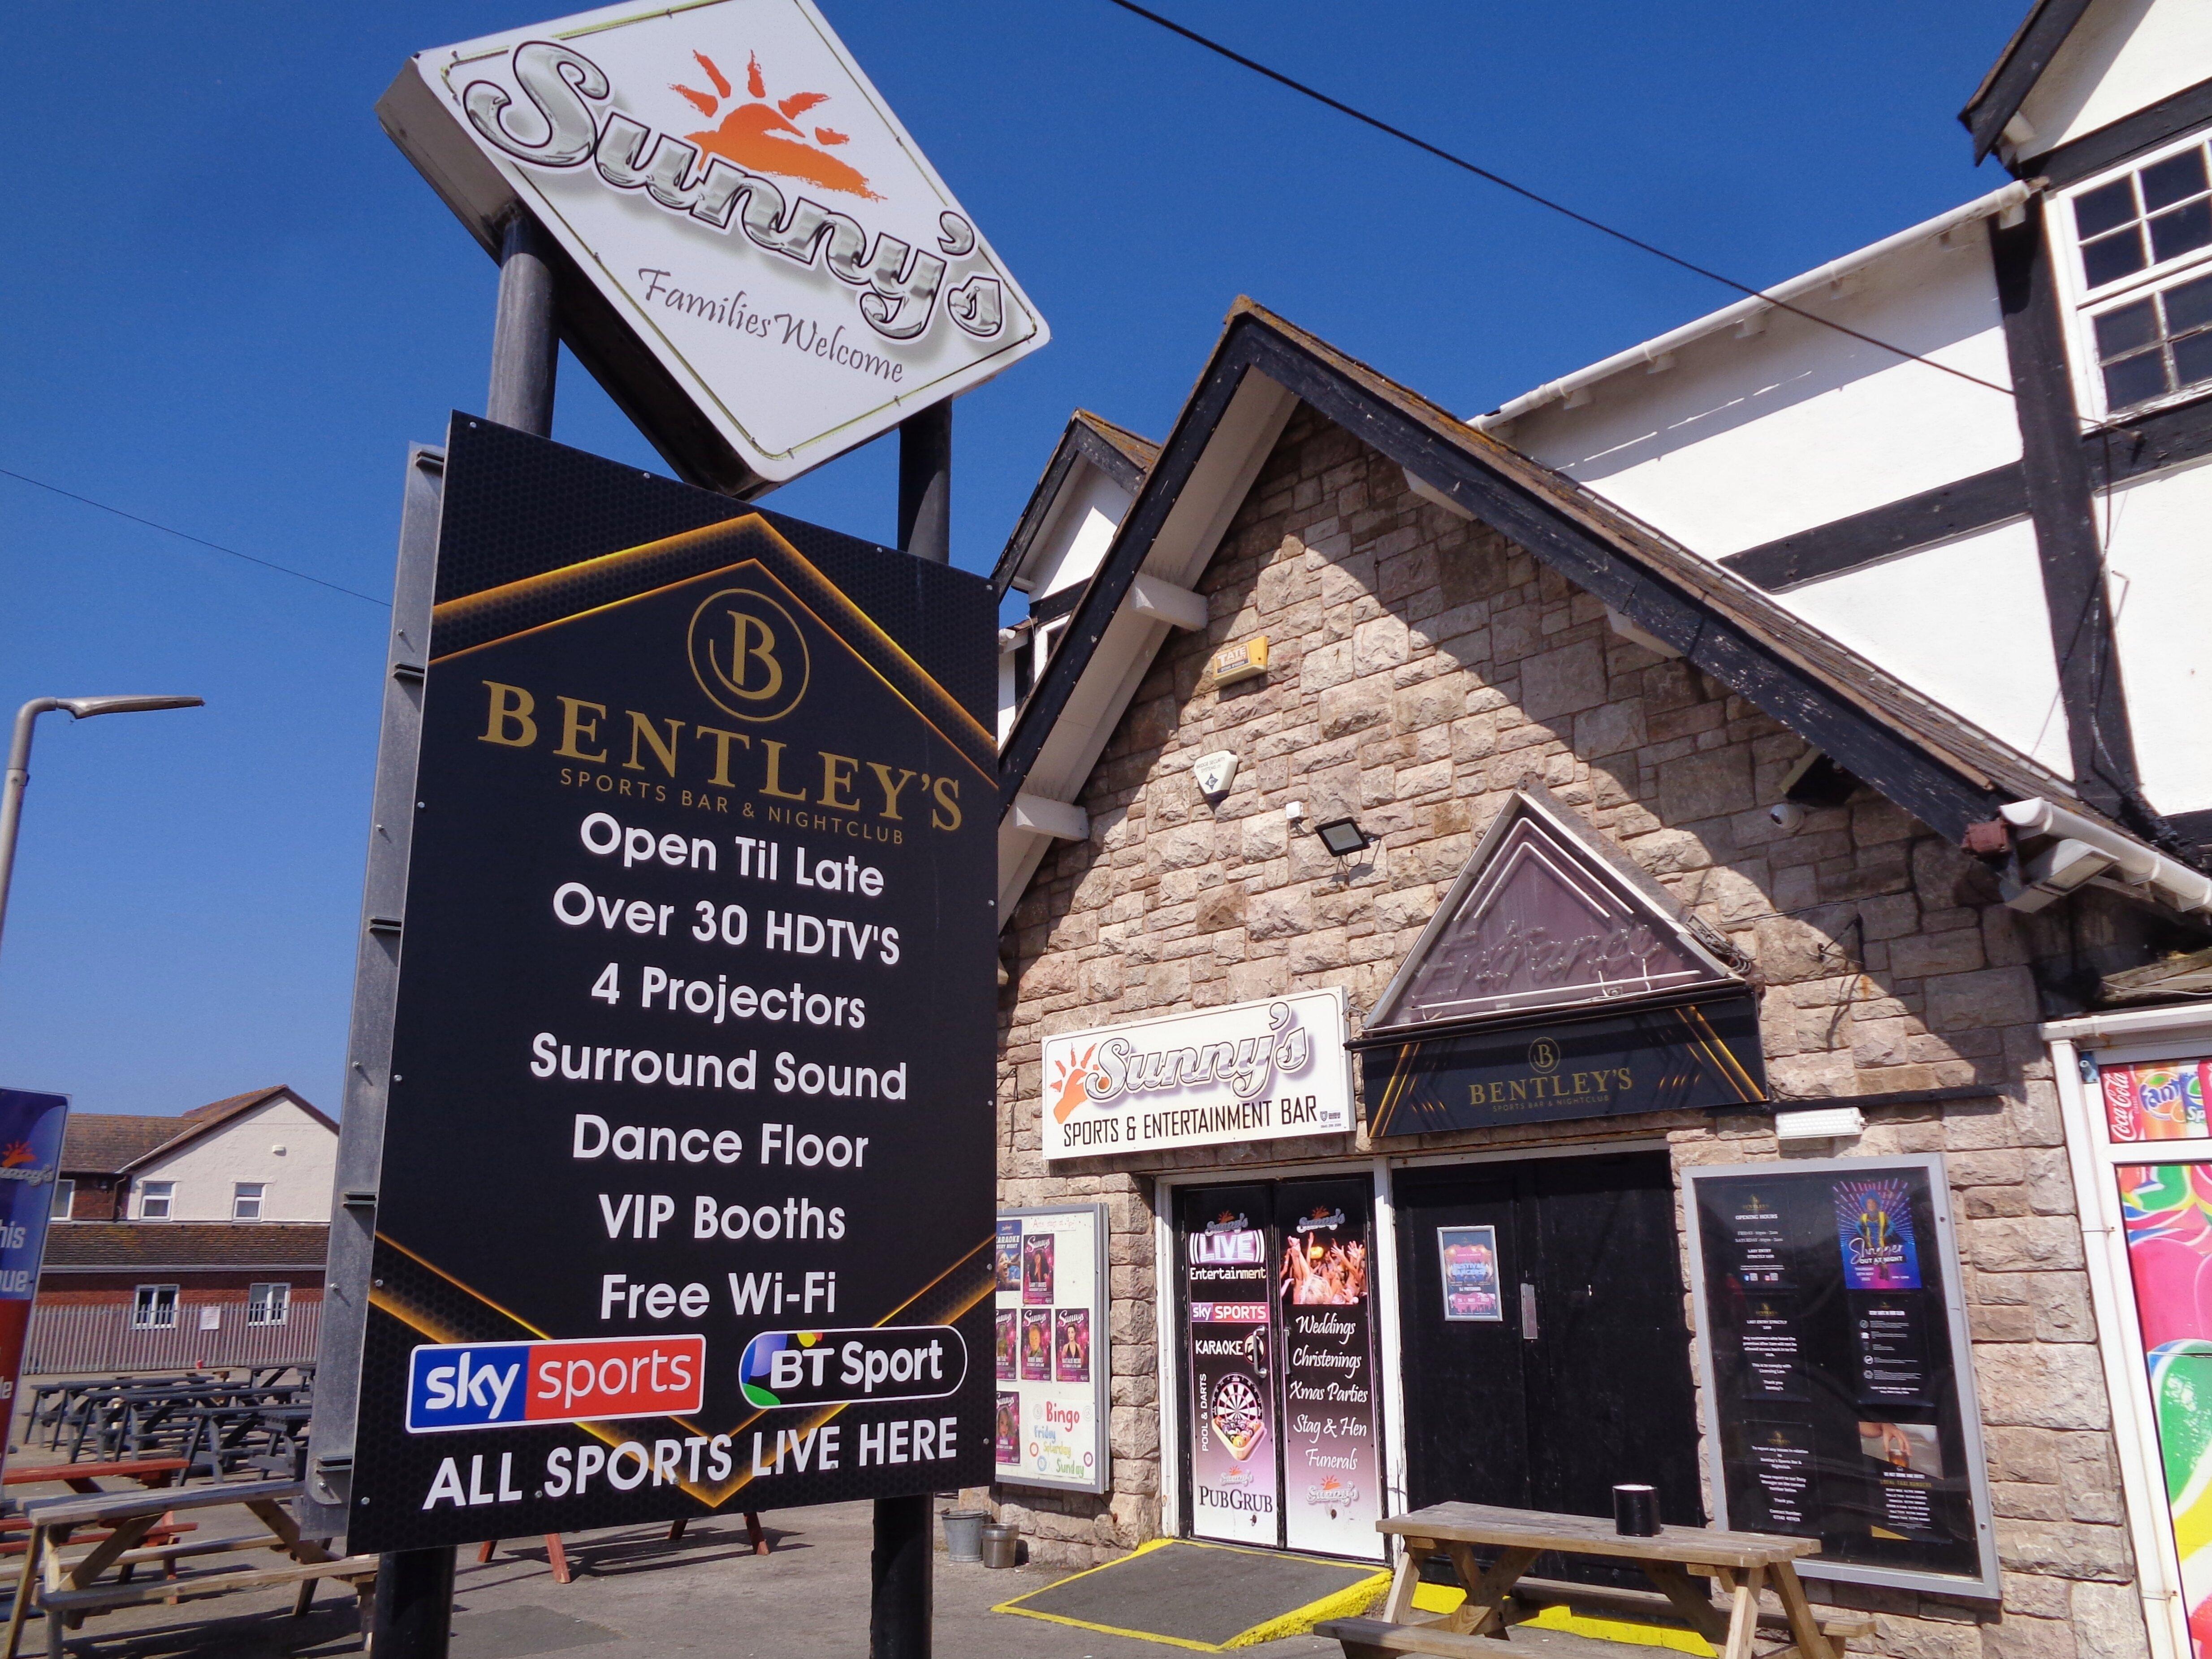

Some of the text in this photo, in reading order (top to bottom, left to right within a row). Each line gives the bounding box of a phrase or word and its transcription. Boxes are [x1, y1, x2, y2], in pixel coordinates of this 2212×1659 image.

[462, 39, 1004, 341] Sunny's
[638, 268, 903, 384] Families Welcome
[709, 610, 782, 700] B
[478, 680, 962, 831] BENTLEY'S
[560, 767, 904, 845] SPORTS BAR & NIGHTCLUB
[581, 812, 884, 897] Open Til Late
[553, 882, 900, 965] Over 30 HDTV'S
[591, 963, 866, 1028] 4 Projectors
[531, 1032, 907, 1100] Surround Sound
[1084, 1001, 1309, 1102] Sunny's
[1469, 1067, 1633, 1105] BENTLEY'S
[2139, 1078, 2181, 1111] Fant
[1492, 1102, 1525, 1112] SPORTS
[1557, 1095, 1609, 1105] NIGHTCLUB
[1064, 1095, 1318, 1147] SPORTS & ENTERTAINMENT BAR
[573, 1114, 869, 1168] Dance Floor
[599, 1194, 846, 1240] VIP Booths
[1205, 1213, 1249, 1236] Sunny's
[1296, 1209, 1345, 1233] Sunny's
[1199, 1233, 1255, 1261] LIVE
[1190, 1266, 1266, 1280] Entertainment
[601, 1272, 836, 1321] Free Wi-Fi
[1193, 1305, 1267, 1321] sky SPORTS
[1024, 1309, 1046, 1326] Sunnys
[1058, 1309, 1084, 1327] Sunnys
[1296, 1312, 1356, 1344] Weddings
[1195, 1340, 1243, 1356] KARAOKE
[1293, 1344, 1361, 1379] Christenings
[769, 1339, 942, 1392] BT Sport
[425, 1349, 692, 1419] sky sports
[1290, 1381, 1368, 1403] Xmas Parties
[1046, 1401, 1080, 1432] Bingo
[1293, 1414, 1367, 1443] Stag & Hen
[1034, 1425, 1056, 1444] Friday
[1043, 1441, 1071, 1459] Saturday
[422, 1417, 958, 1510] ALL SPORTS LIVE HERE
[1056, 1458, 1084, 1478] Sunday
[1305, 1448, 1357, 1470] Funerals
[1220, 1470, 1253, 1486] Sunny's
[1306, 1481, 1359, 1506] Sunny's
